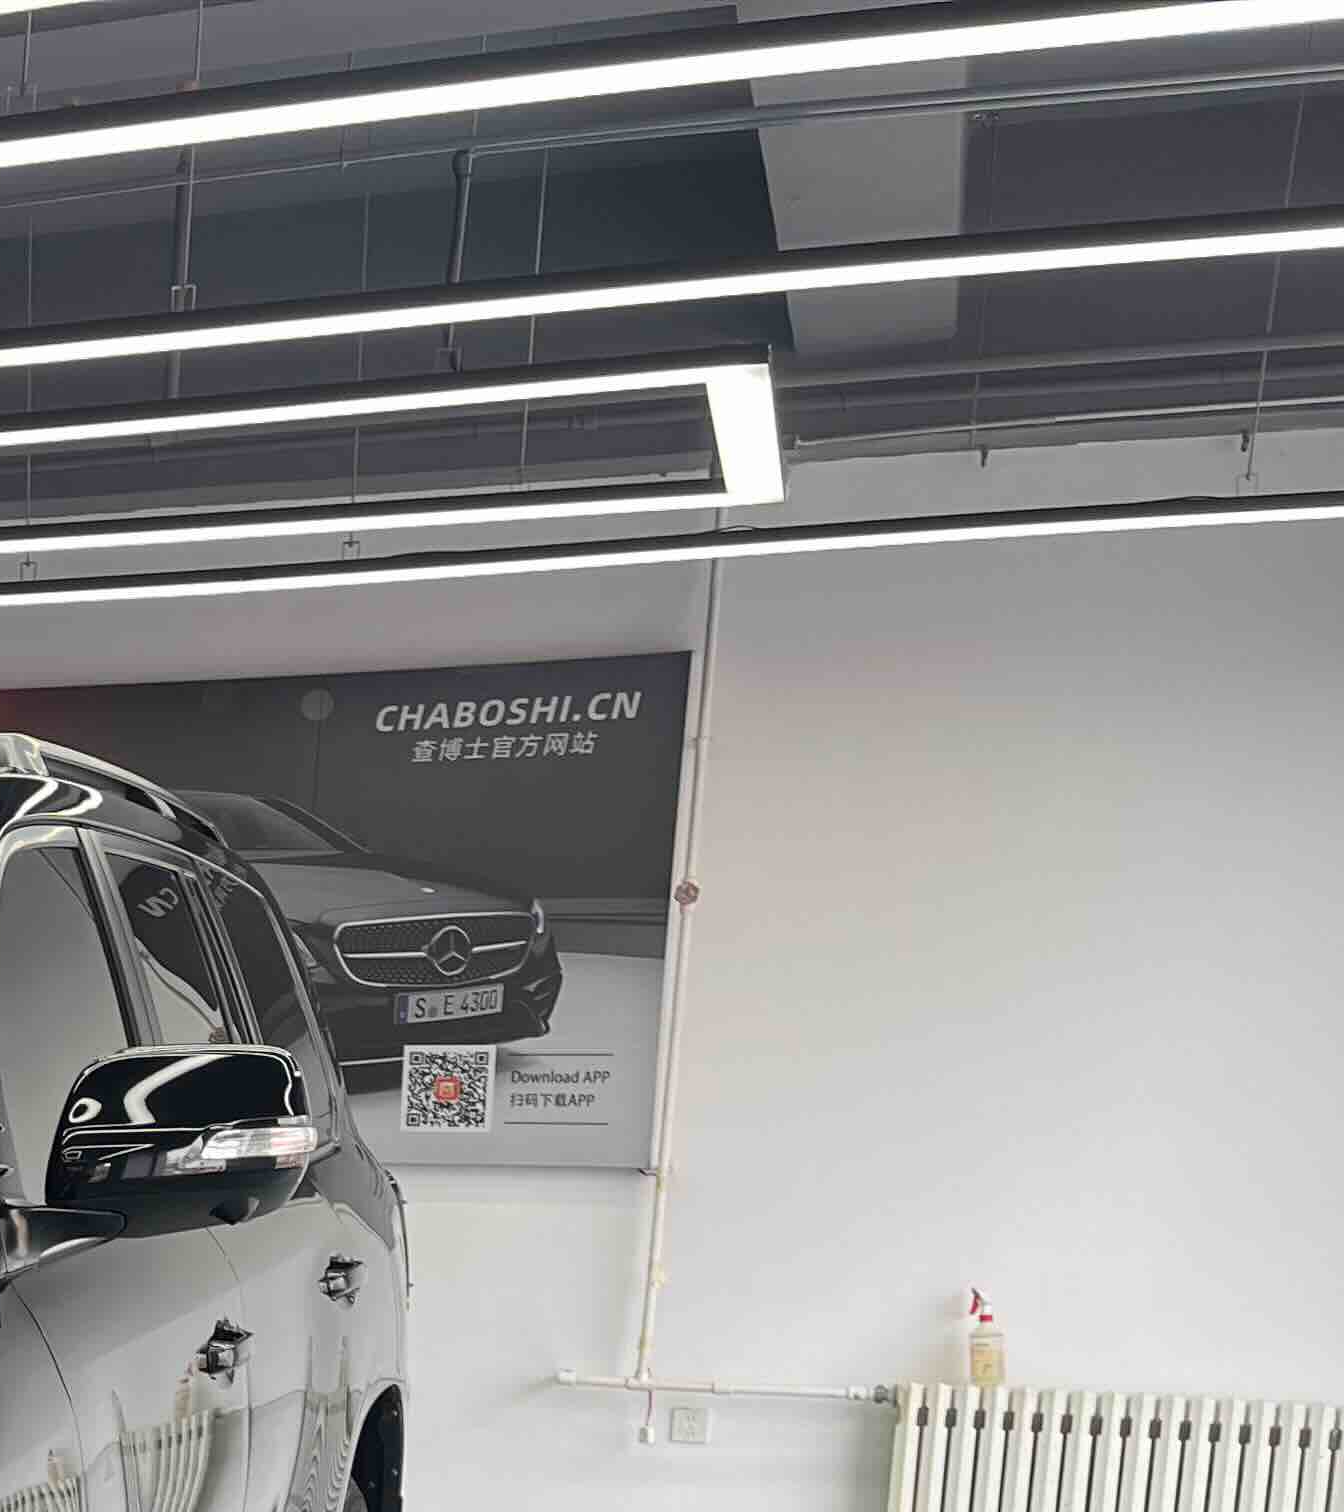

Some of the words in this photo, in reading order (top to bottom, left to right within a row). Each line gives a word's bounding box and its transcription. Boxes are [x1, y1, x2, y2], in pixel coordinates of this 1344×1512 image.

[375, 691, 642, 732] CHABOSHI.CN
[412, 731, 598, 762] 查博士官方网站
[512, 1071, 577, 1083] Download
[583, 1071, 610, 1083] APP
